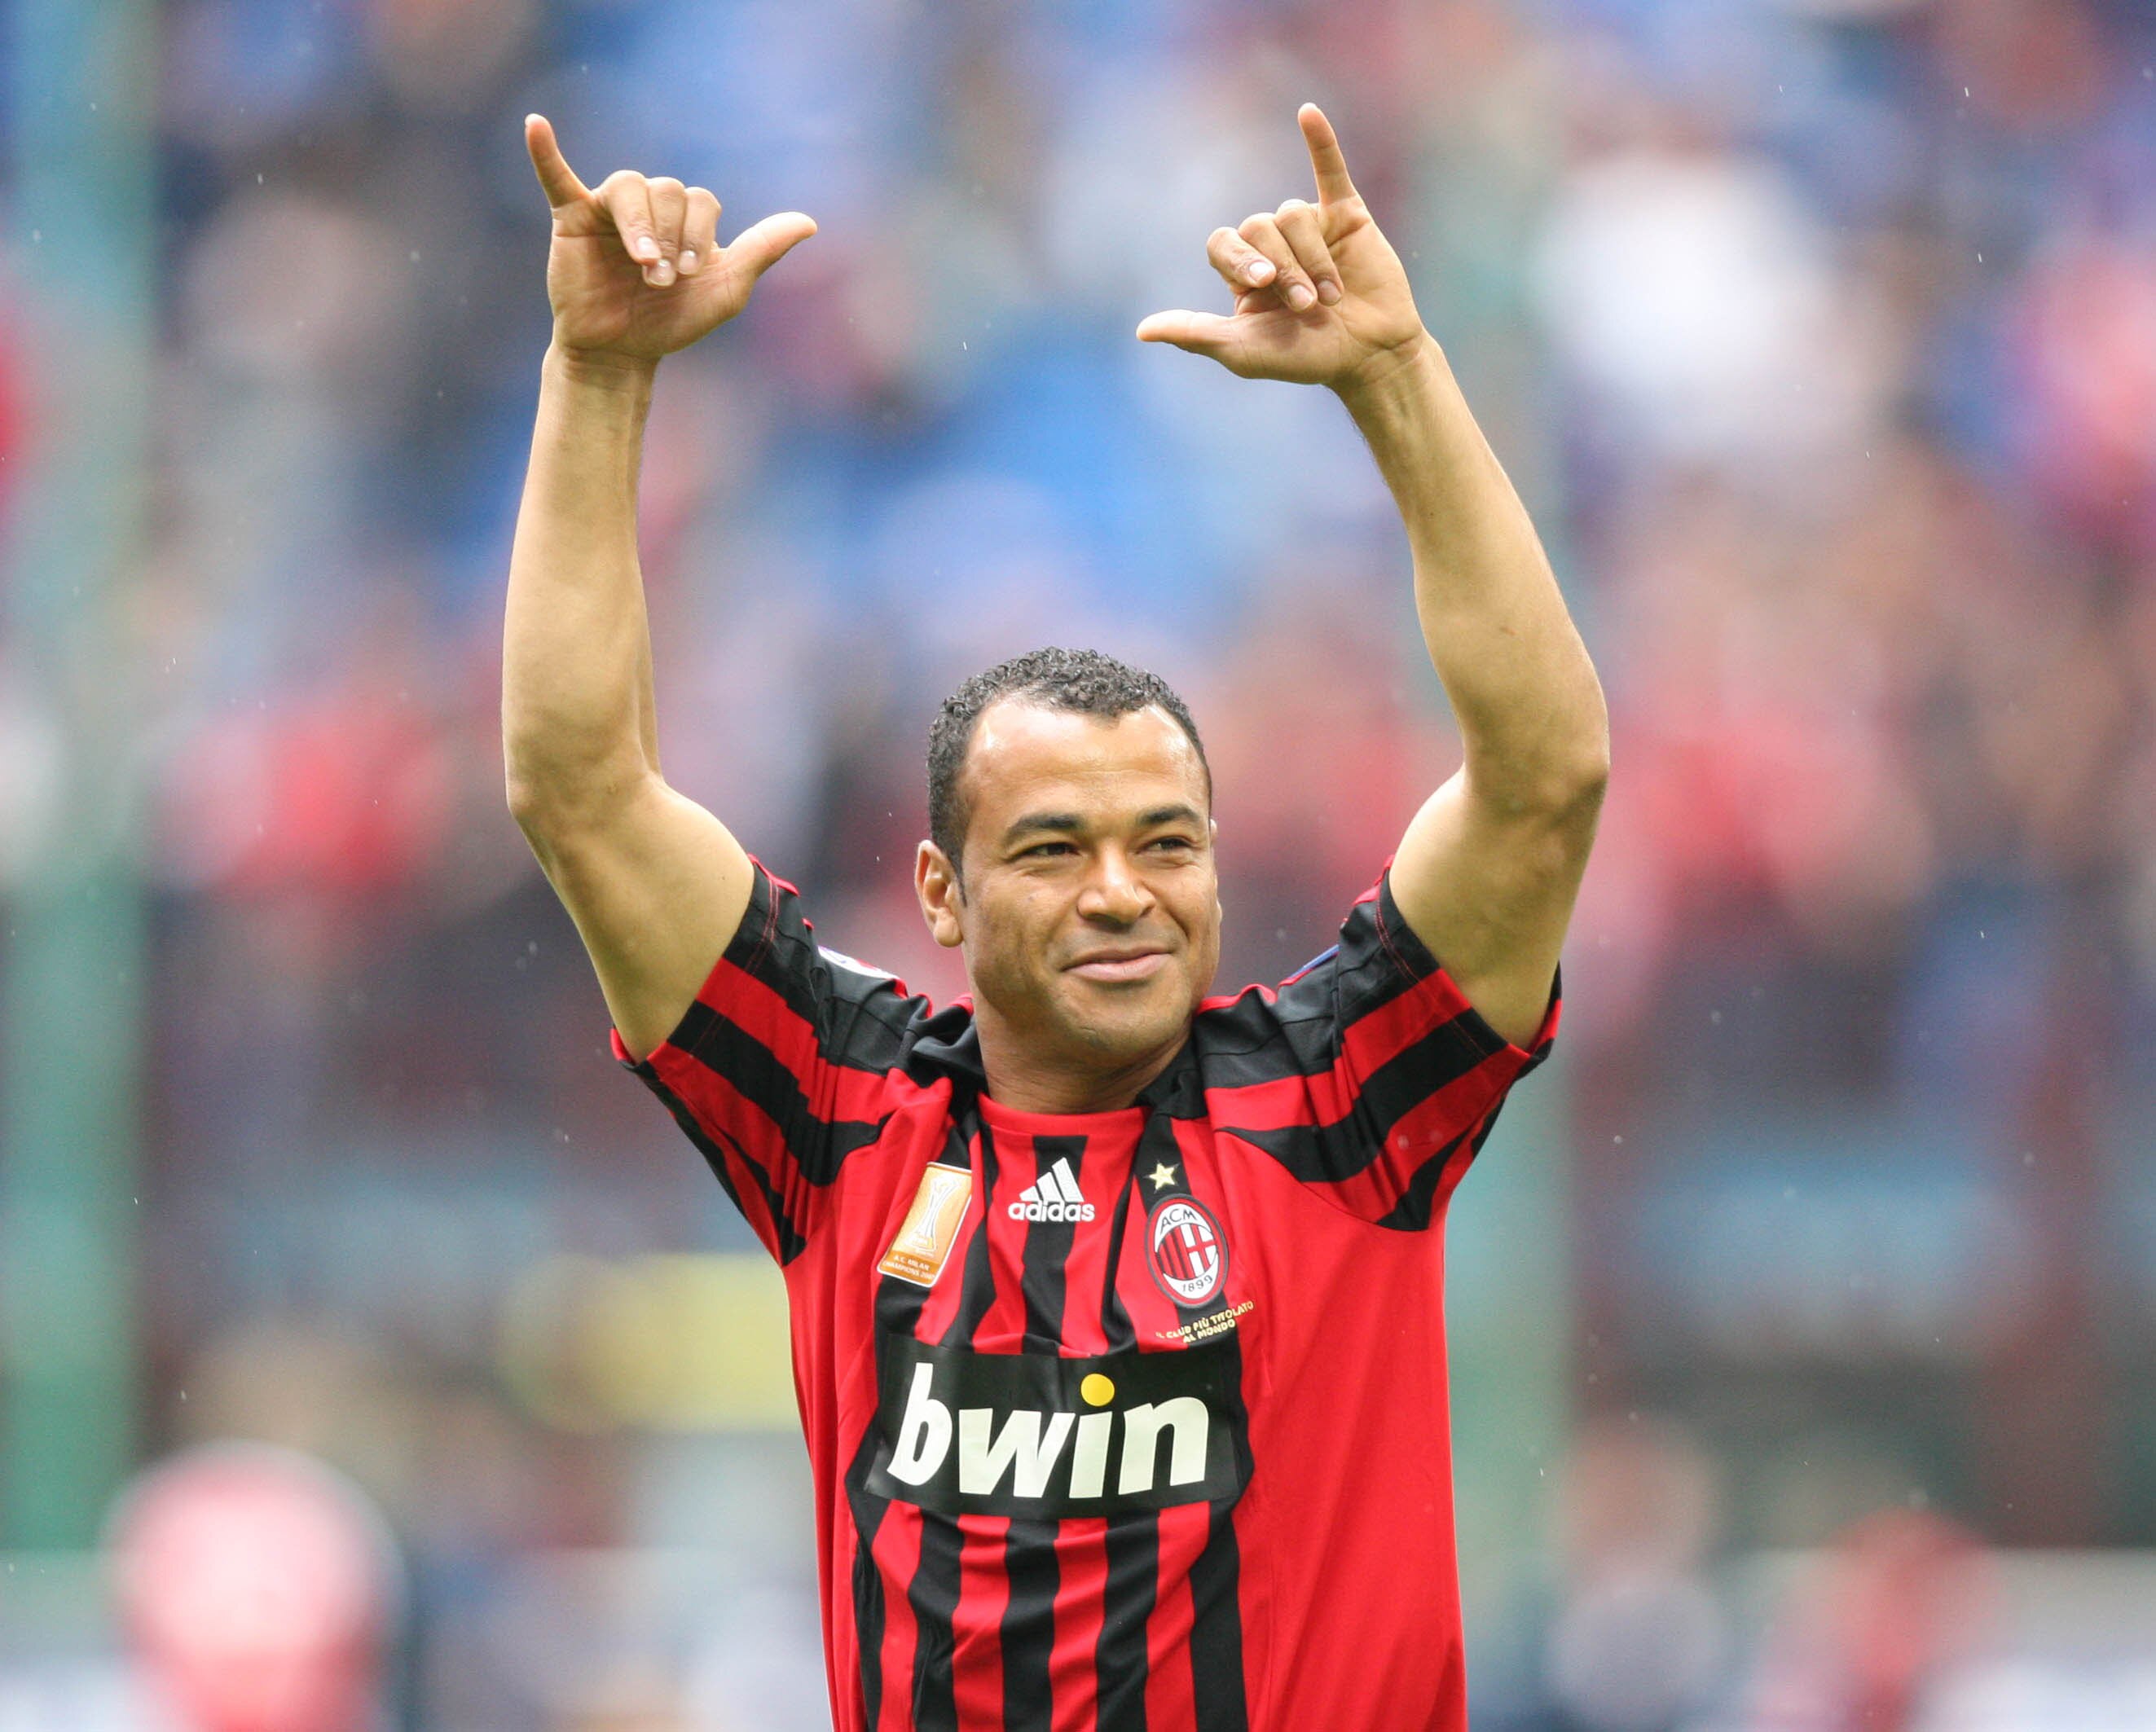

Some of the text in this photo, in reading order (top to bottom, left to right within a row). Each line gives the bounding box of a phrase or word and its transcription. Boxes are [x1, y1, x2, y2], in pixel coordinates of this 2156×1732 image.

[1008, 1200, 1095, 1222] adidas
[1159, 1208, 1198, 1235] ACM
[1182, 1274, 1213, 1293] 1899
[1210, 1300, 1254, 1325] TITOLATO
[1183, 1318, 1236, 1343] AL MONDO
[887, 1362, 1208, 1499] bwin
